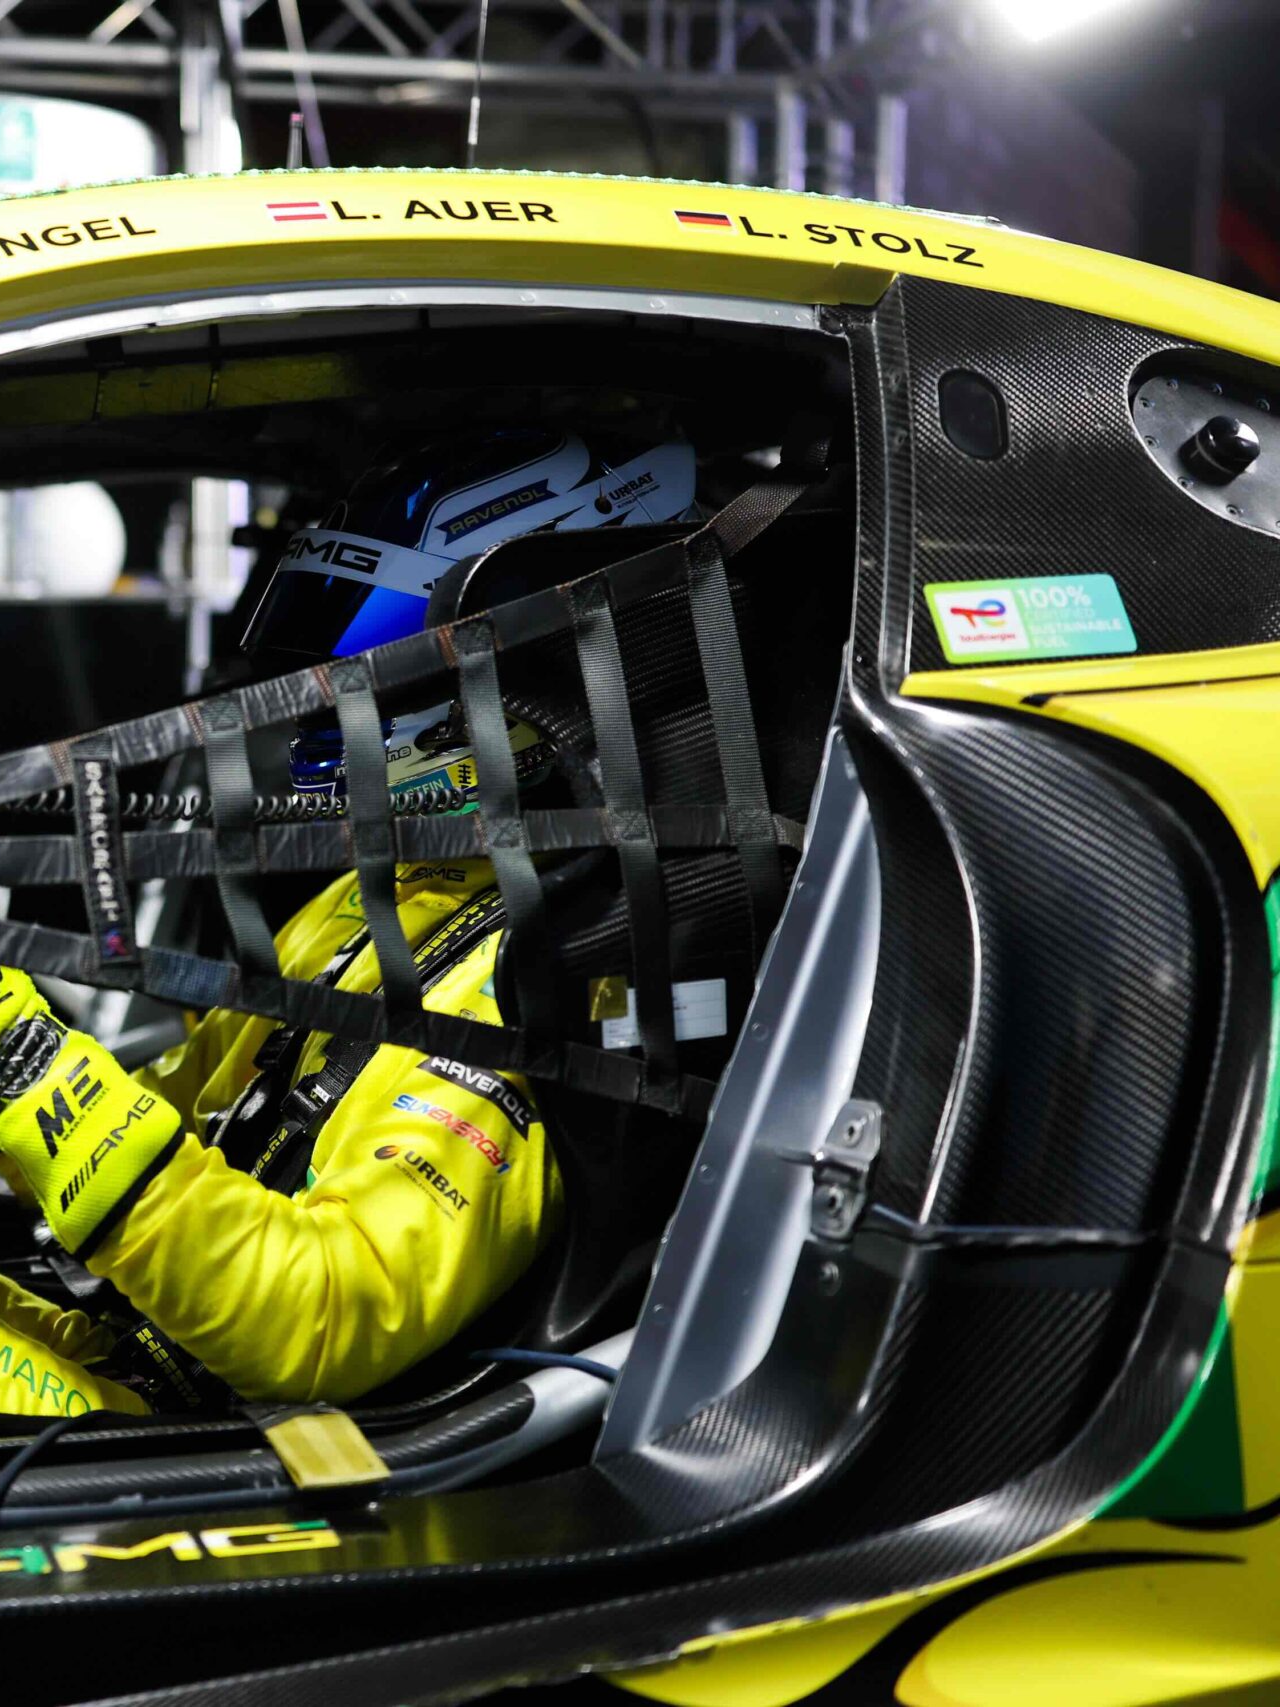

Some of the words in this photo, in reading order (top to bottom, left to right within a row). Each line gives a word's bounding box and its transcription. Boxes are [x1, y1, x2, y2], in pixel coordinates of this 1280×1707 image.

[330, 200, 382, 220] L.
[404, 200, 559, 223] AUER
[739, 216, 788, 239] L.
[804, 223, 985, 268] STOLZ
[448, 488, 548, 536] RAVENOL
[1017, 584, 1092, 608] 100%
[431, 1056, 529, 1125] RAVENOL
[404, 1151, 470, 1212] URBAT
